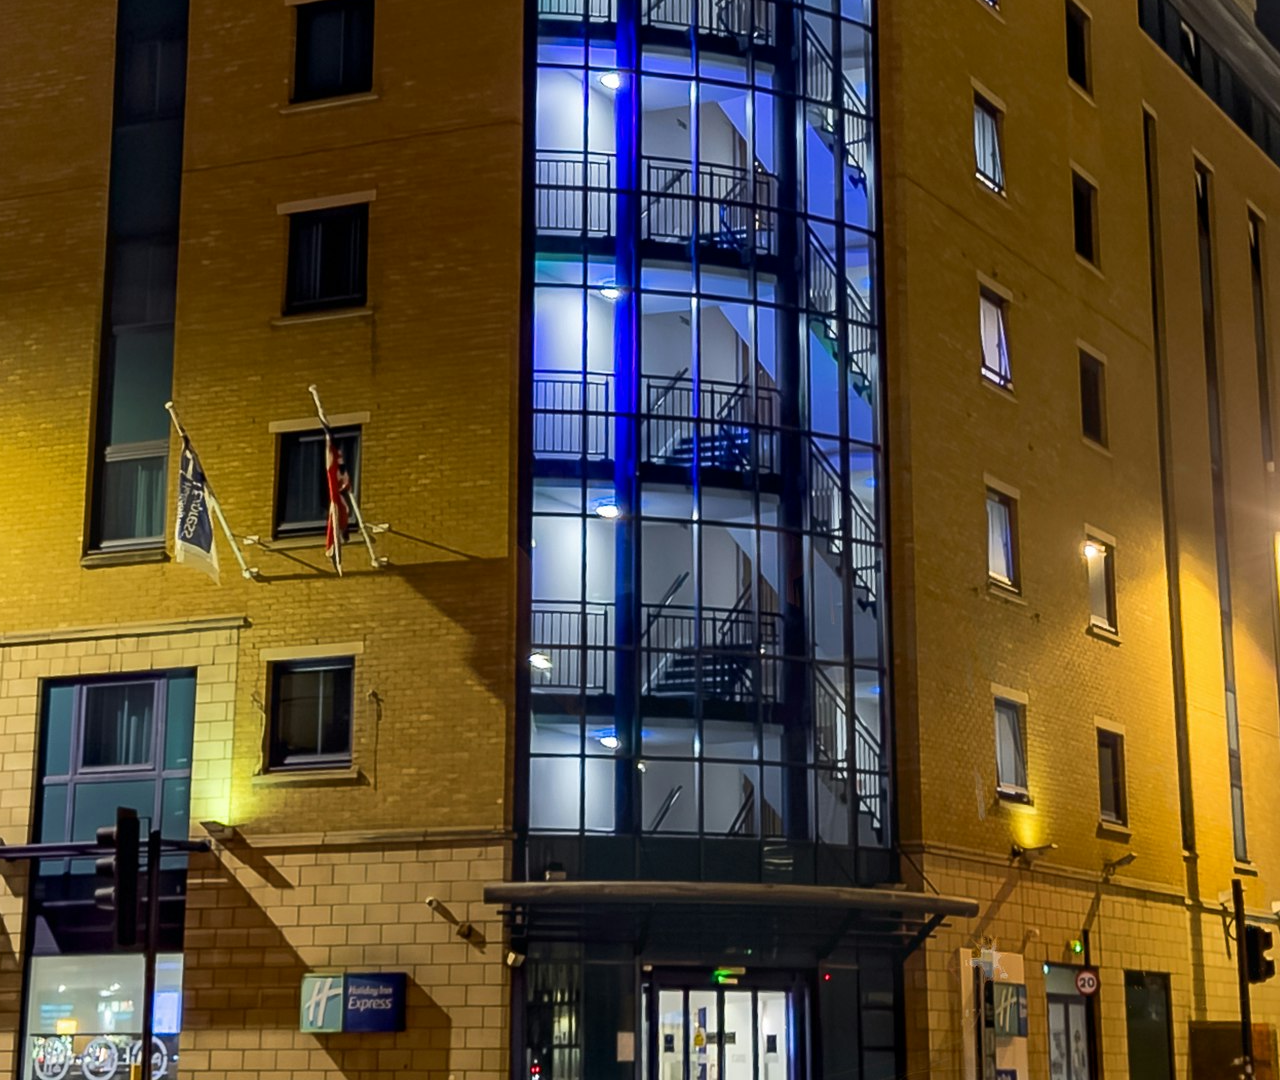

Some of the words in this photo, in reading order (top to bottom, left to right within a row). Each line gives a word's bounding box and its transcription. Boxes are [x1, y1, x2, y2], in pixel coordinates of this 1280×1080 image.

[1079, 977, 1096, 988] 20
[349, 985, 378, 997] Holiday
[379, 985, 392, 995] Inn
[348, 996, 392, 1012] Express
